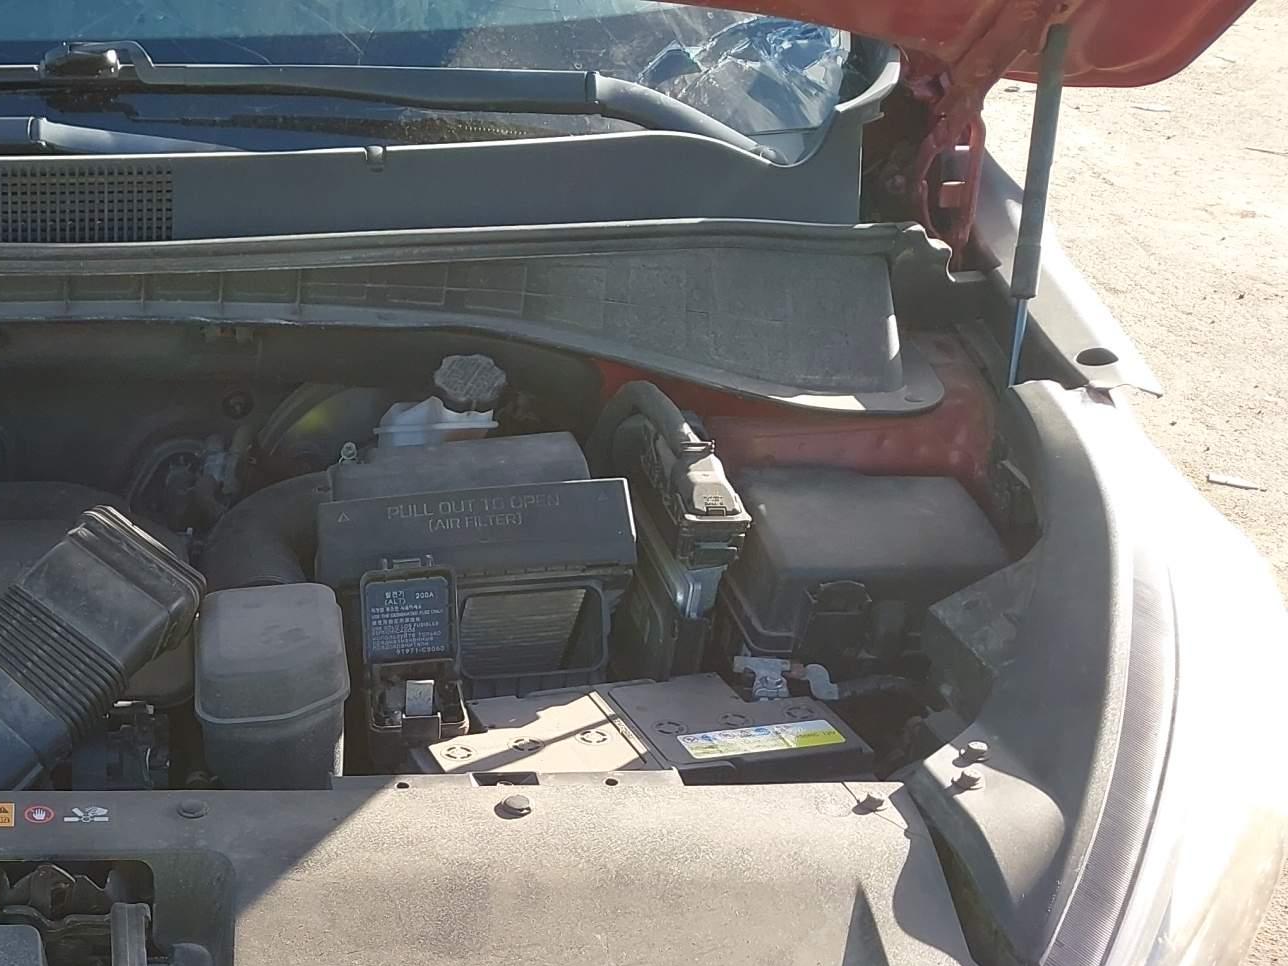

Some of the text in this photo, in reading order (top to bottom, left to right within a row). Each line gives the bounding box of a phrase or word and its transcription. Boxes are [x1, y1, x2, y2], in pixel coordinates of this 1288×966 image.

[387, 493, 560, 520] PULL OUT TO OPEN
